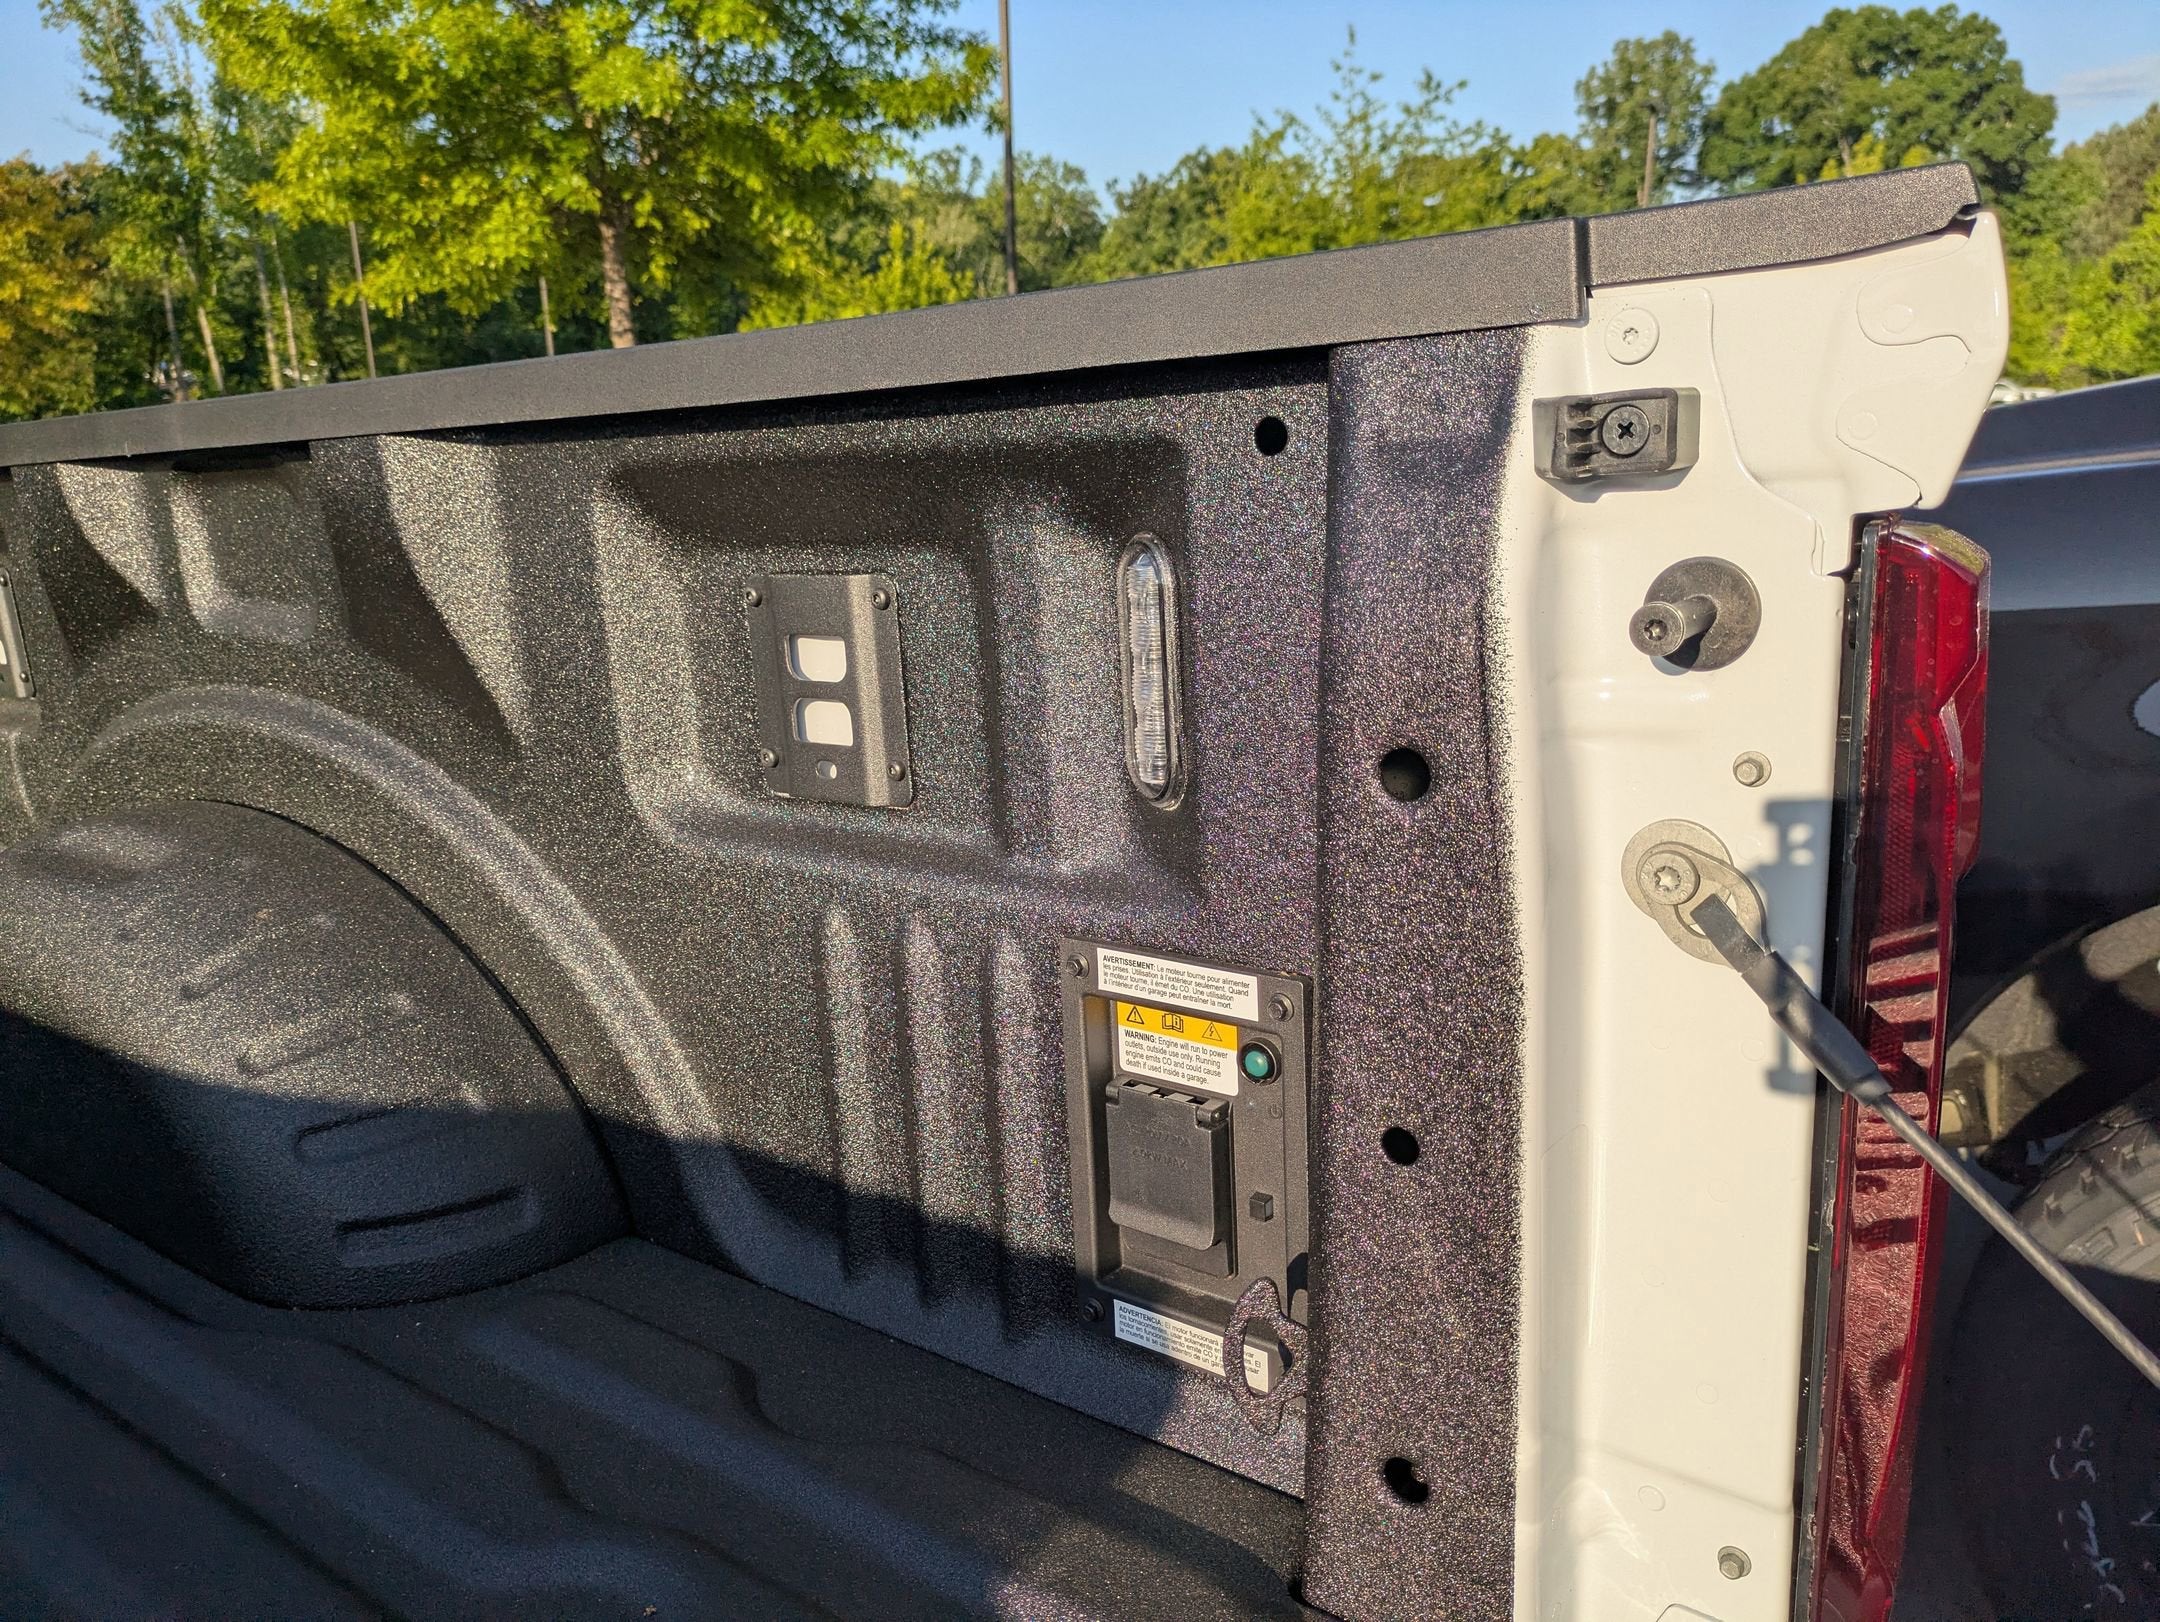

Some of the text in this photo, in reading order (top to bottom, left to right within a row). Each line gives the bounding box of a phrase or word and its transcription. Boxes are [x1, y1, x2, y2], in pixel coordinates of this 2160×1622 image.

[1103, 955, 1156, 971] AVERTISSEMENT:
[1166, 967, 1185, 976] moteur
[1187, 971, 1205, 980] tourne
[1207, 975, 1220, 984] pour
[1222, 976, 1250, 988] alimenter
[1103, 962, 1111, 970] les
[1132, 968, 1158, 979] Utilisation
[1165, 974, 1193, 985] l'extérieur
[1228, 986, 1248, 996] Quand
[1110, 972, 1128, 981] moteur
[1155, 980, 1169, 989] émet
[1193, 987, 1204, 996] Une
[1206, 990, 1234, 1001] utilisation
[1135, 983, 1146, 992] d'un
[1148, 987, 1167, 998] garage
[1169, 991, 1181, 1001] peut
[1183, 993, 1209, 1004] entraîner
[1217, 1000, 1232, 1009] mort.
[1125, 1029, 1157, 1043] WARNING:
[1158, 1037, 1178, 1049] Engine
[1180, 1041, 1189, 1051] will
[1191, 1045, 1200, 1053] run
[1209, 1049, 1228, 1058] power
[1147, 1046, 1167, 1056] outside
[1181, 1053, 1194, 1063] only.
[1196, 1056, 1220, 1069] Running
[1126, 1049, 1221, 1077] engine emits CO and could cause
[1126, 1059, 1142, 1069] death
[1148, 1064, 1161, 1073] used
[1163, 1066, 1180, 1077] inside
[1187, 1073, 1209, 1084] garage.
[1119, 1305, 1163, 1326] ADVERTENCIA:
[1172, 1326, 1188, 1334] motor
[1120, 1320, 1134, 1329] motor
[1203, 1349, 1213, 1358] CO
